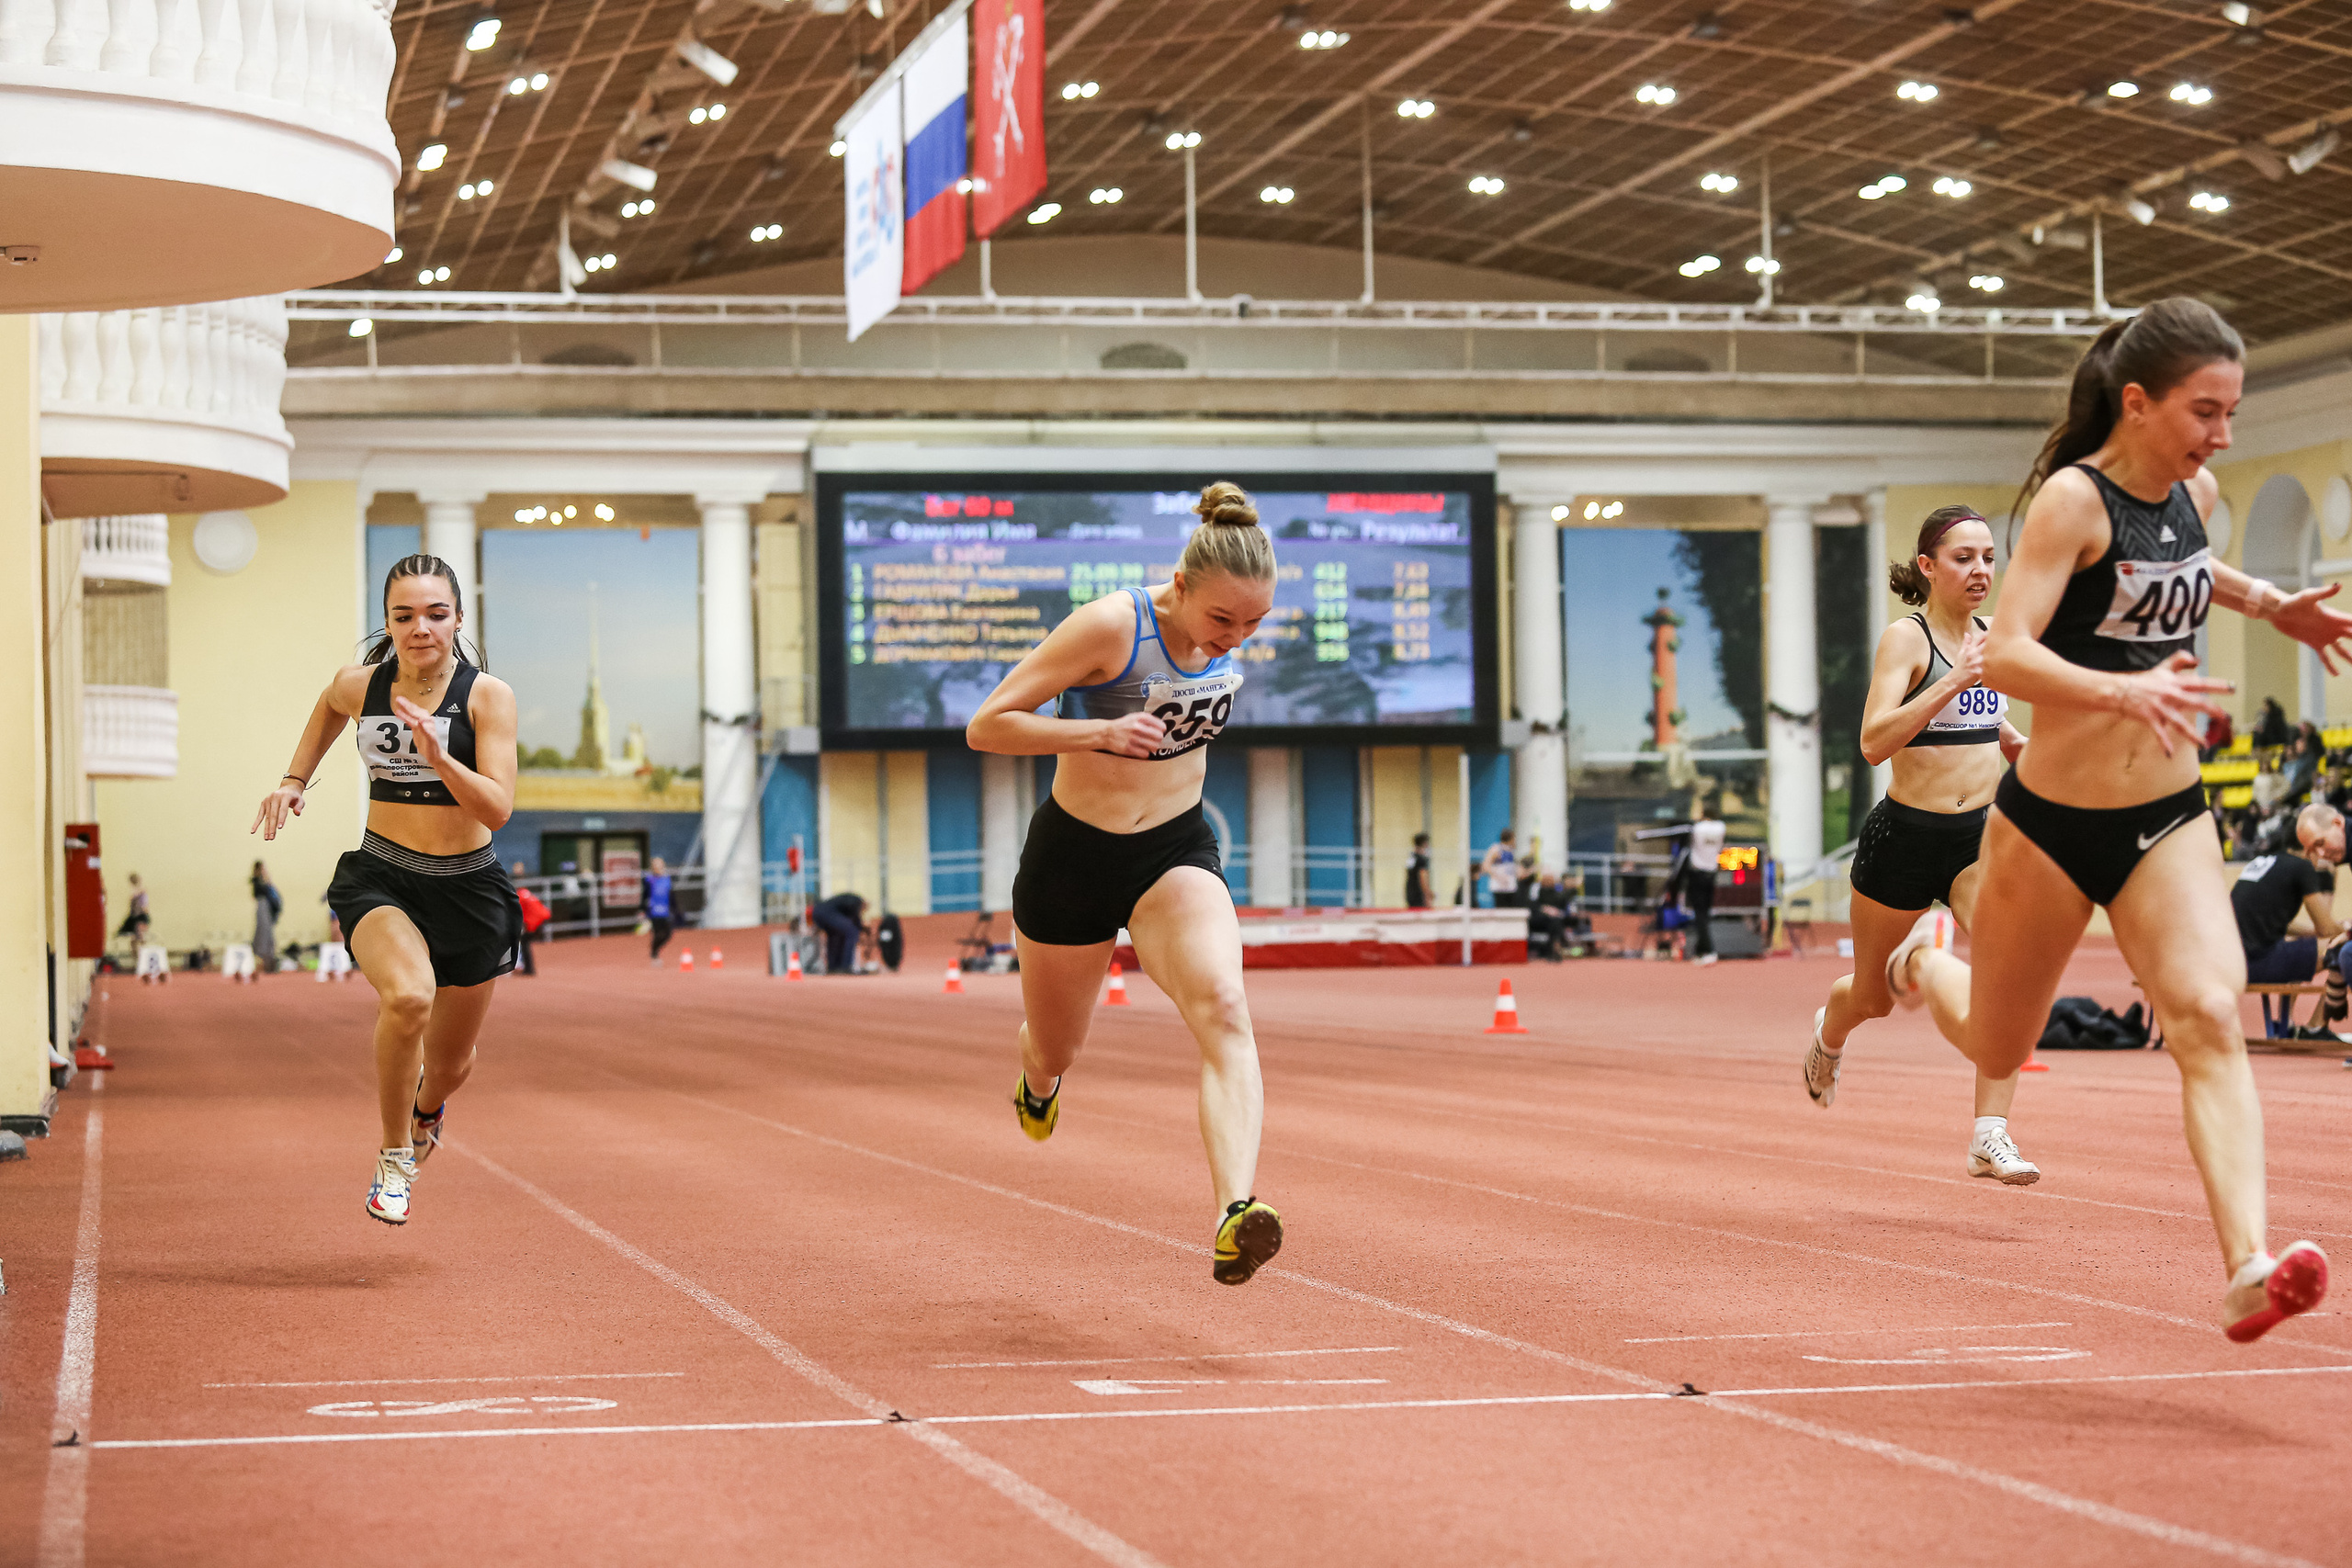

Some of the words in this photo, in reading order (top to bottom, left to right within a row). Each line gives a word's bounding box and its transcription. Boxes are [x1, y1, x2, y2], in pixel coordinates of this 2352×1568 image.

[2120, 568, 2214, 636] 400
[1151, 693, 1232, 743] 659
[1959, 689, 1999, 716] 989
